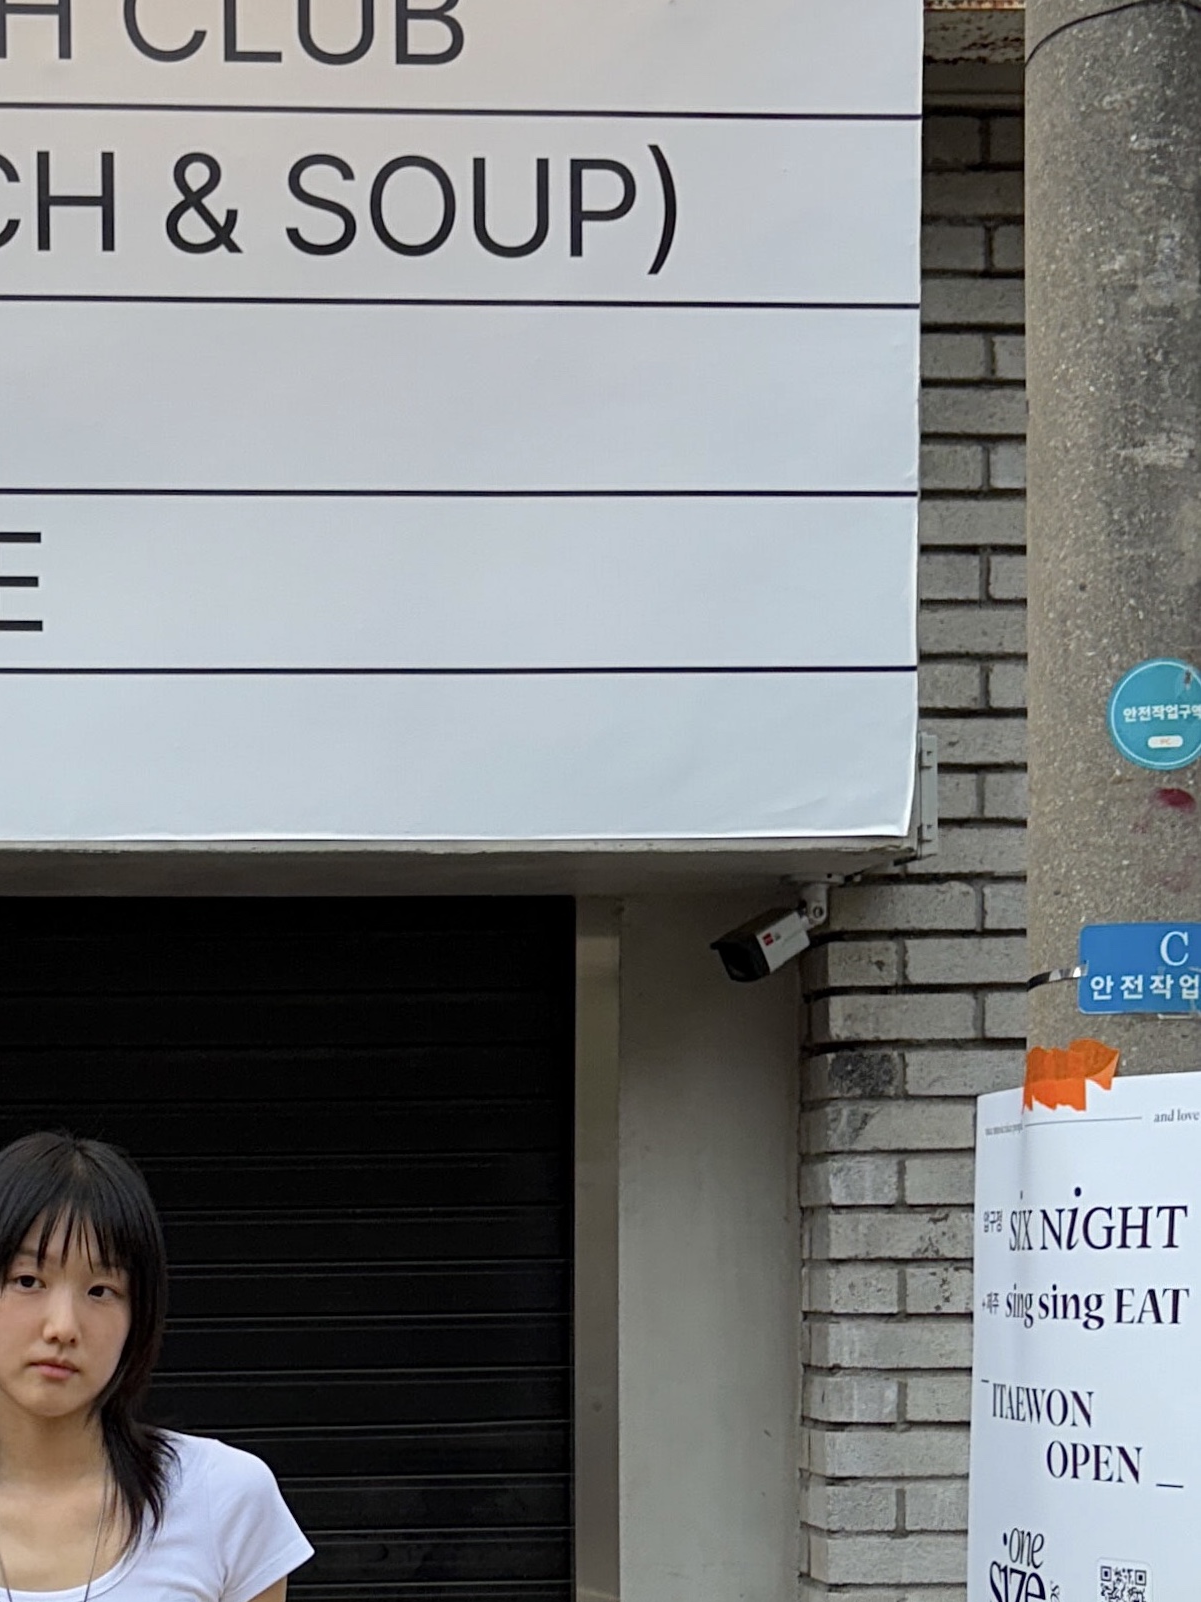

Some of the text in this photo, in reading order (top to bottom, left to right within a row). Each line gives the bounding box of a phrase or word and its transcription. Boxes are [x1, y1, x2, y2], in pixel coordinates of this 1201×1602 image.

[165, 152, 243, 254] &
[285, 144, 677, 275] SOUP)
[1154, 1110, 1174, 1123] and
[1005, 1283, 1034, 1328] sing
[1038, 1284, 1105, 1330] sing
[1114, 1288, 1190, 1324] EAT
[992, 1383, 1094, 1428] ITAEWON
[1046, 1440, 1143, 1484] OPEN
